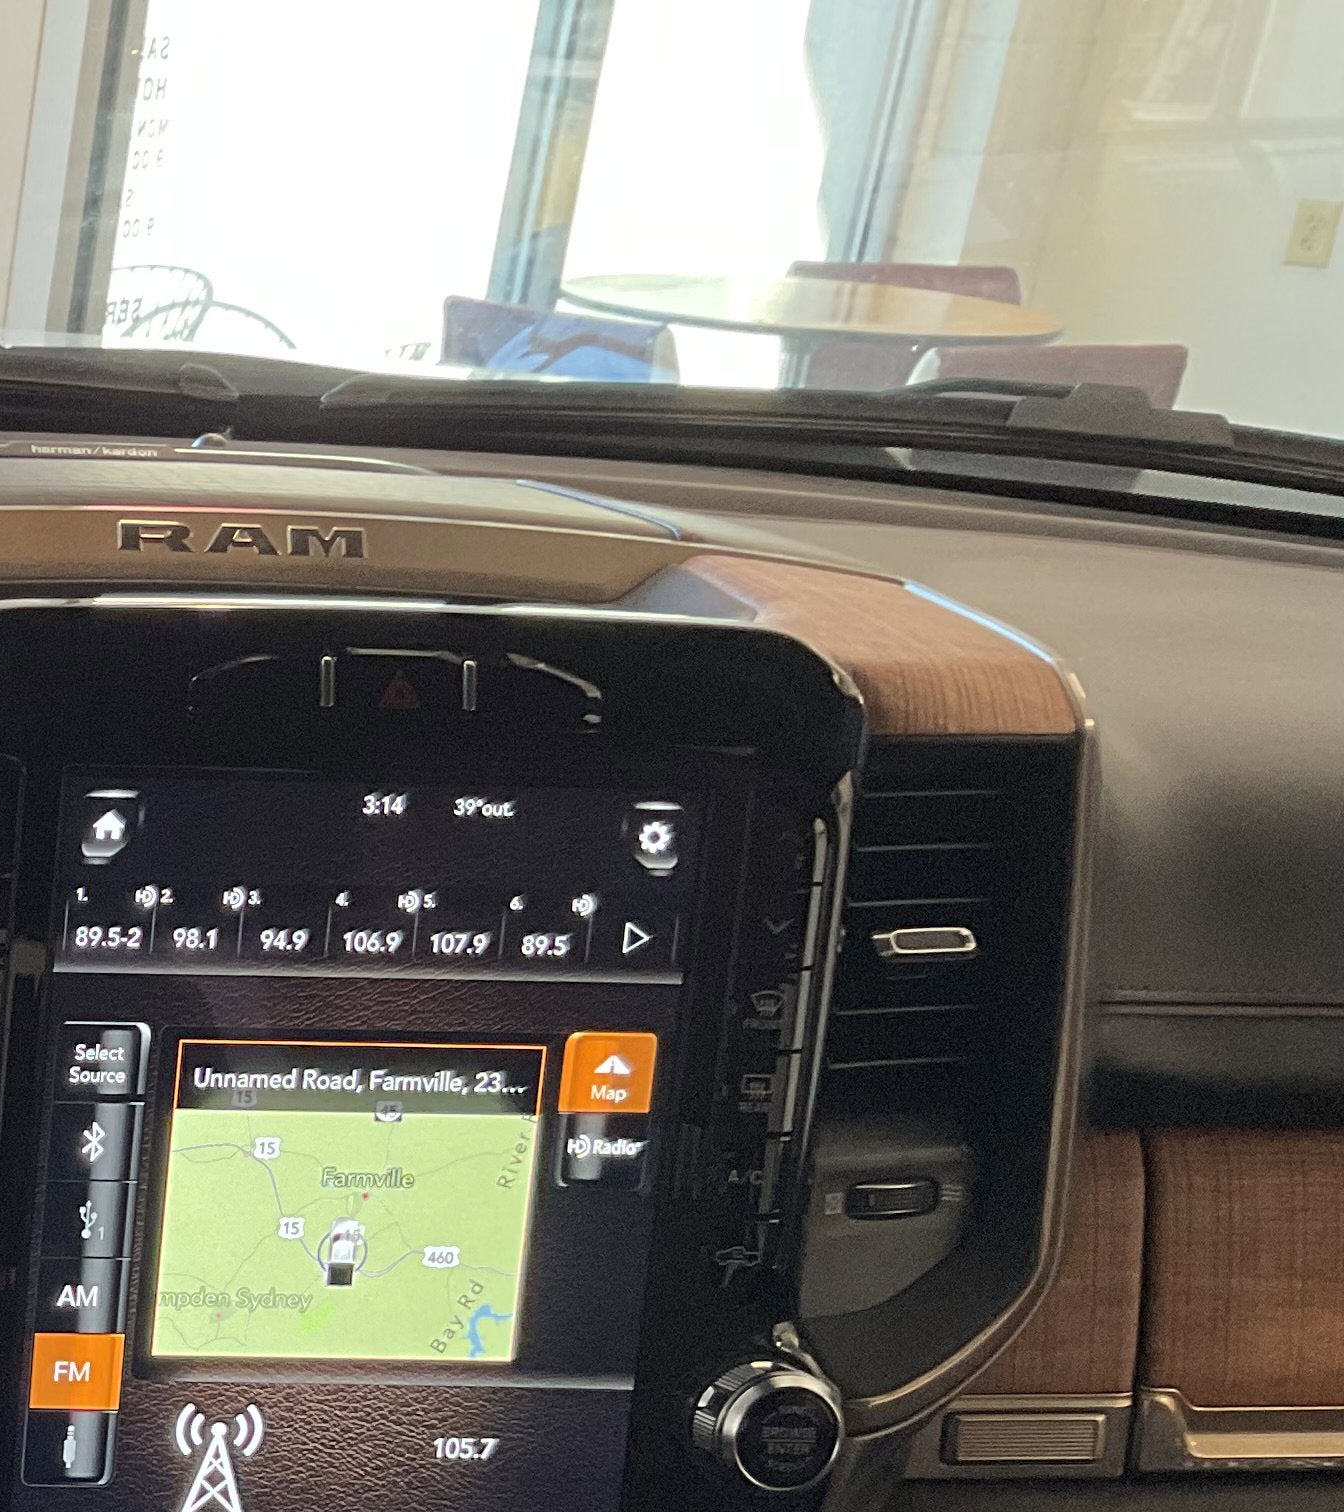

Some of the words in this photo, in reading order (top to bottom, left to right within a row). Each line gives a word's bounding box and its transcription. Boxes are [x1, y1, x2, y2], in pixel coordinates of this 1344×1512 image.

[117, 518, 368, 560] RAM
[362, 794, 406, 815] 3:14
[76, 887, 89, 901] 1.
[75, 926, 143, 947] 89.5-2
[173, 928, 218, 949] 98.1
[260, 929, 309, 950] 94.9
[343, 931, 403, 953] 106.9
[430, 932, 490, 955] 107.9
[521, 934, 570, 956] 89.5
[74, 1044, 124, 1063] Select
[69, 1067, 125, 1085] Source
[194, 1067, 297, 1091] Unnamed
[302, 1069, 363, 1094] Road,
[369, 1072, 468, 1096] Farmville,
[474, 1073, 526, 1095] 23...
[590, 1085, 628, 1103] Map
[259, 1142, 276, 1155] 15
[496, 1132, 531, 1190] River
[321, 1167, 415, 1189] Farmville
[284, 1221, 300, 1236] 15
[428, 1251, 454, 1265] 460
[56, 1284, 98, 1307] AM
[235, 1286, 313, 1313] Sydney
[430, 1312, 466, 1354] Bay
[458, 1280, 485, 1309] Rd
[54, 1361, 91, 1382] FM
[433, 1437, 496, 1461] 105.7
